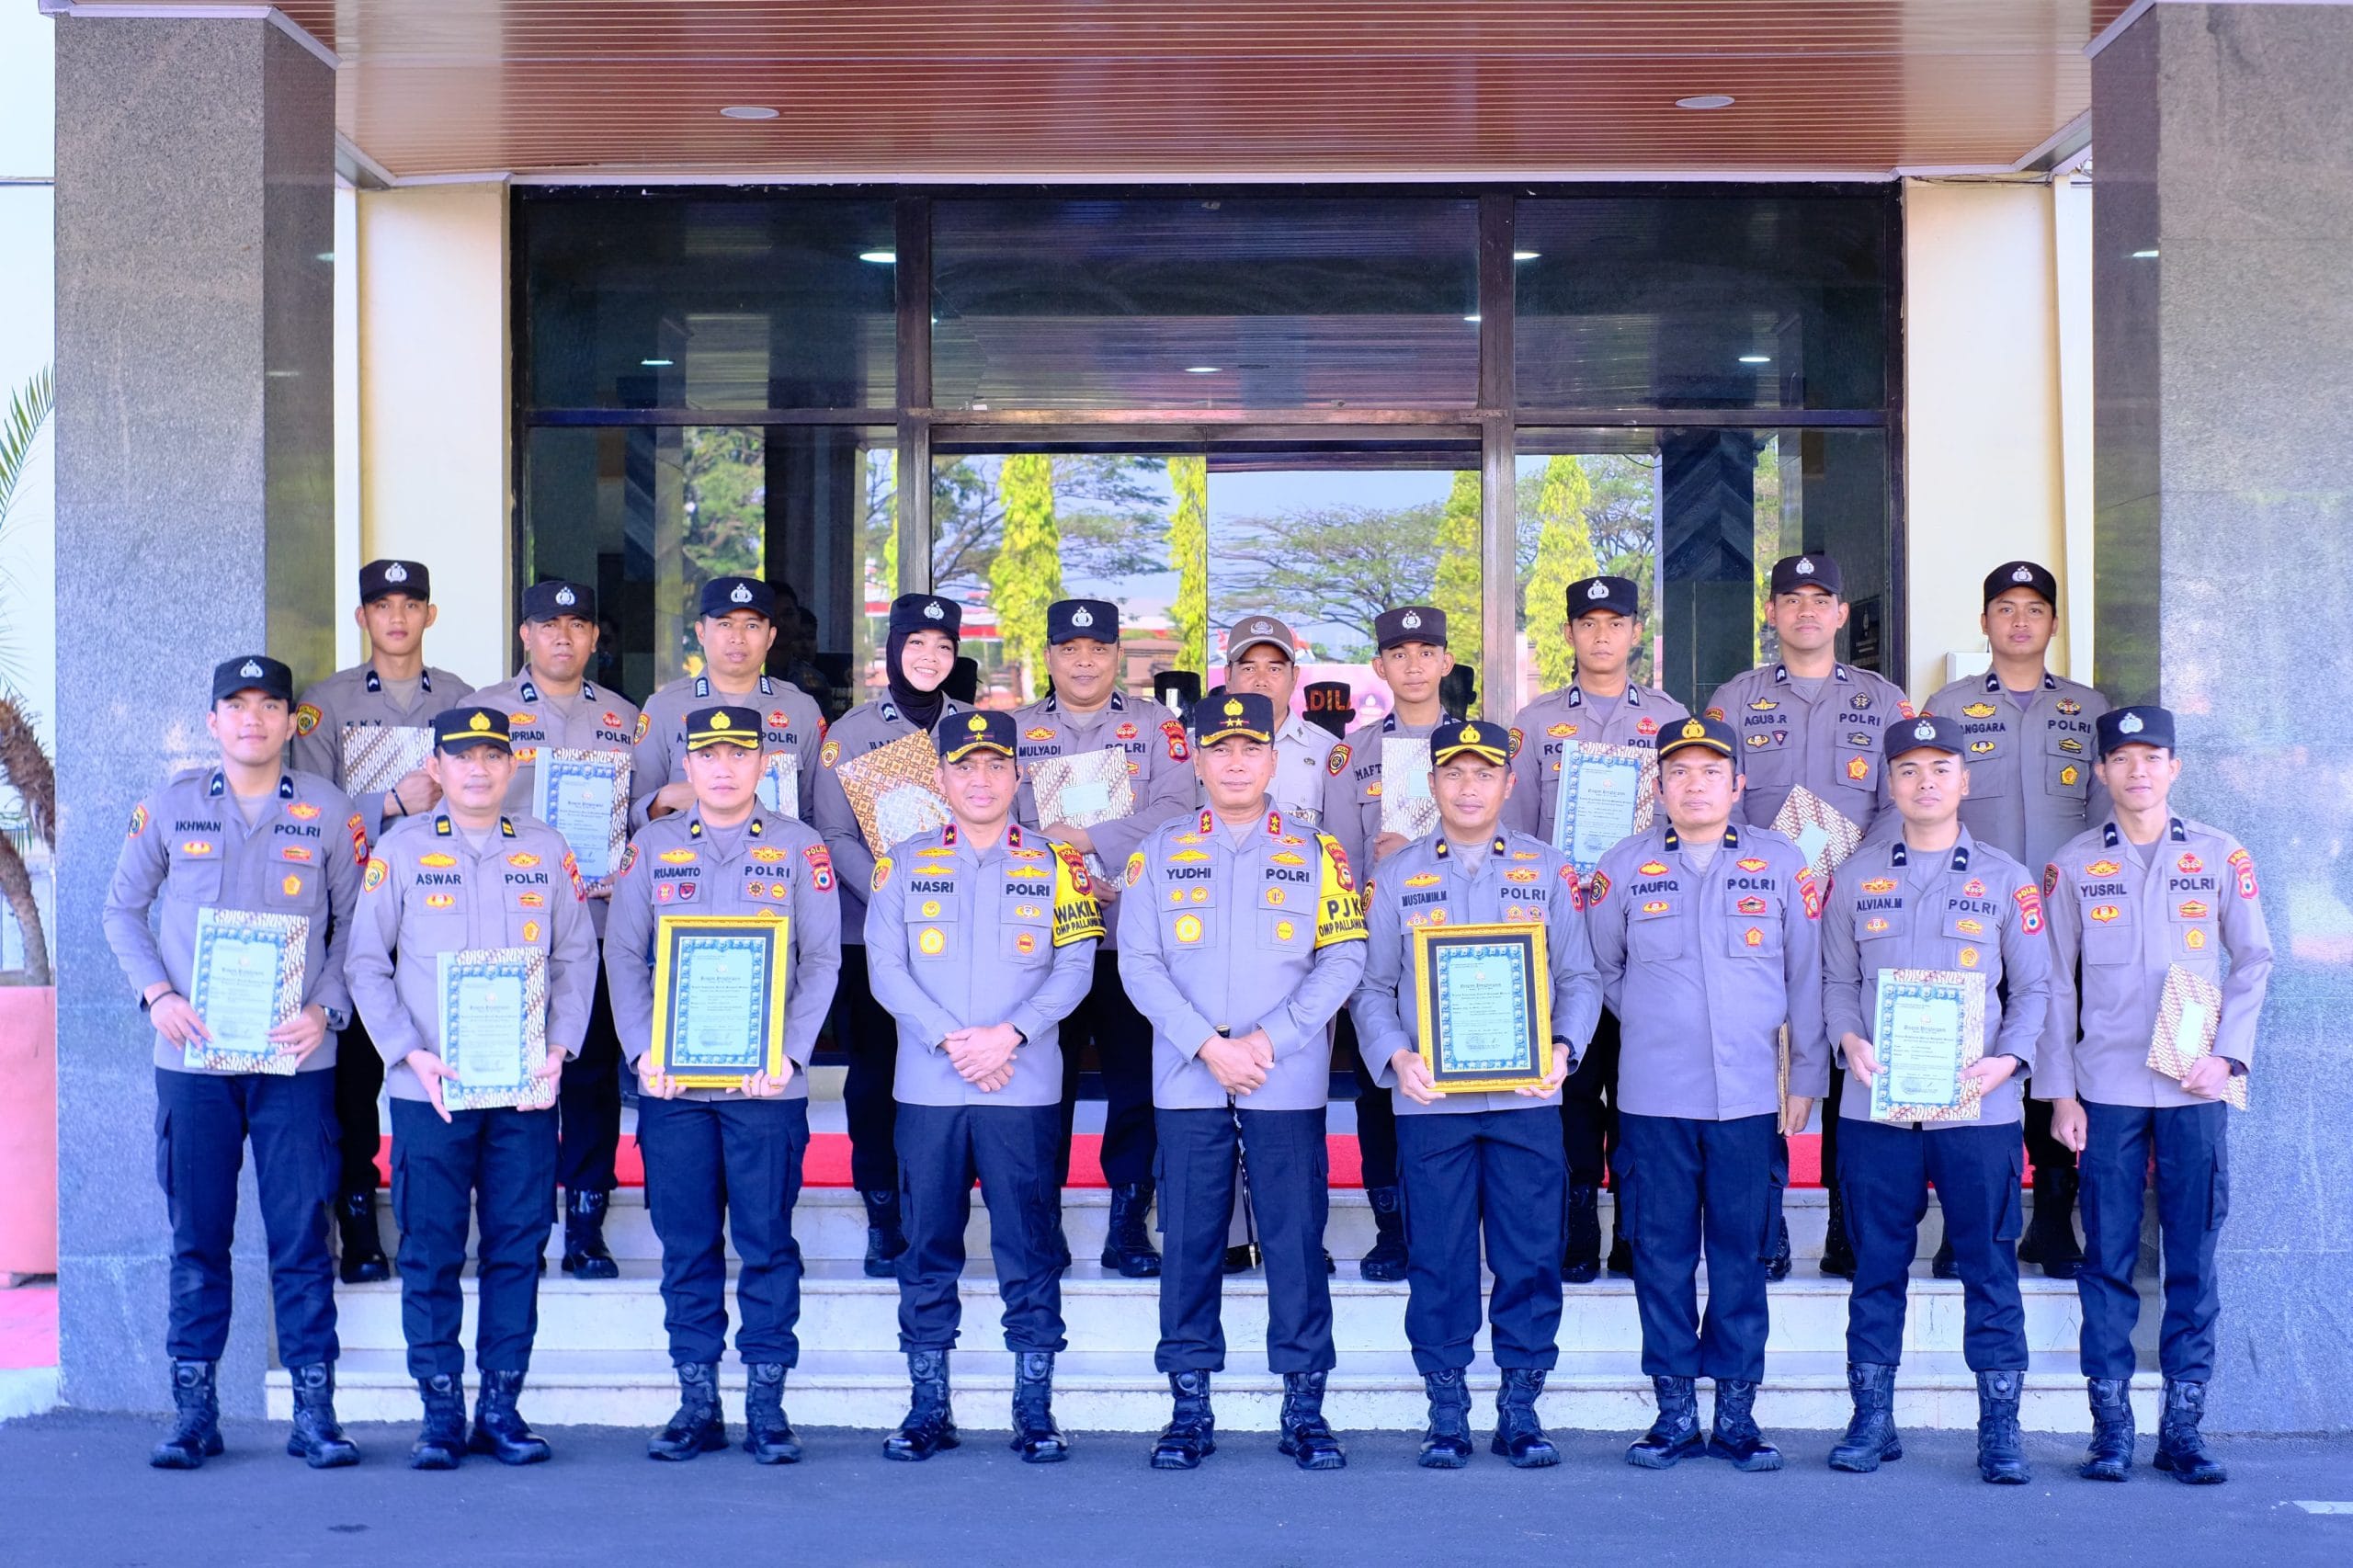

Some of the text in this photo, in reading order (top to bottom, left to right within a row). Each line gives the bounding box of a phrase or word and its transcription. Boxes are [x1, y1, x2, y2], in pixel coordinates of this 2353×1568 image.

[1310, 689, 1351, 711] DIL
[1839, 713, 1881, 727] POLRI
[2047, 720, 2091, 734] POLRI
[596, 730, 631, 745] POLRI
[1018, 745, 1062, 757] MULYADI
[175, 821, 222, 833] IKHWAN
[274, 824, 321, 838] POLRI
[415, 873, 461, 886] ASWAR
[505, 872, 549, 885] POLRI
[654, 867, 701, 880] RUJIANTO
[745, 866, 790, 879] POLRI
[1166, 867, 1211, 881] YUDHI
[1266, 868, 1310, 883] POLRI
[911, 881, 954, 893] NASRI
[1006, 882, 1051, 897] POLRI
[1630, 880, 1679, 896] TAUFIQ
[1727, 878, 1776, 892] POLRI
[2080, 883, 2128, 898] YUSRIL
[2169, 877, 2215, 892] POLRI
[1500, 887, 1546, 902] POLRI
[1856, 897, 1903, 913] ALVIAN.M
[1948, 898, 1996, 916] POLRI
[1053, 900, 1096, 925] WAKIL
[1055, 924, 1070, 937] OMP
[1318, 924, 1334, 937] OMP
